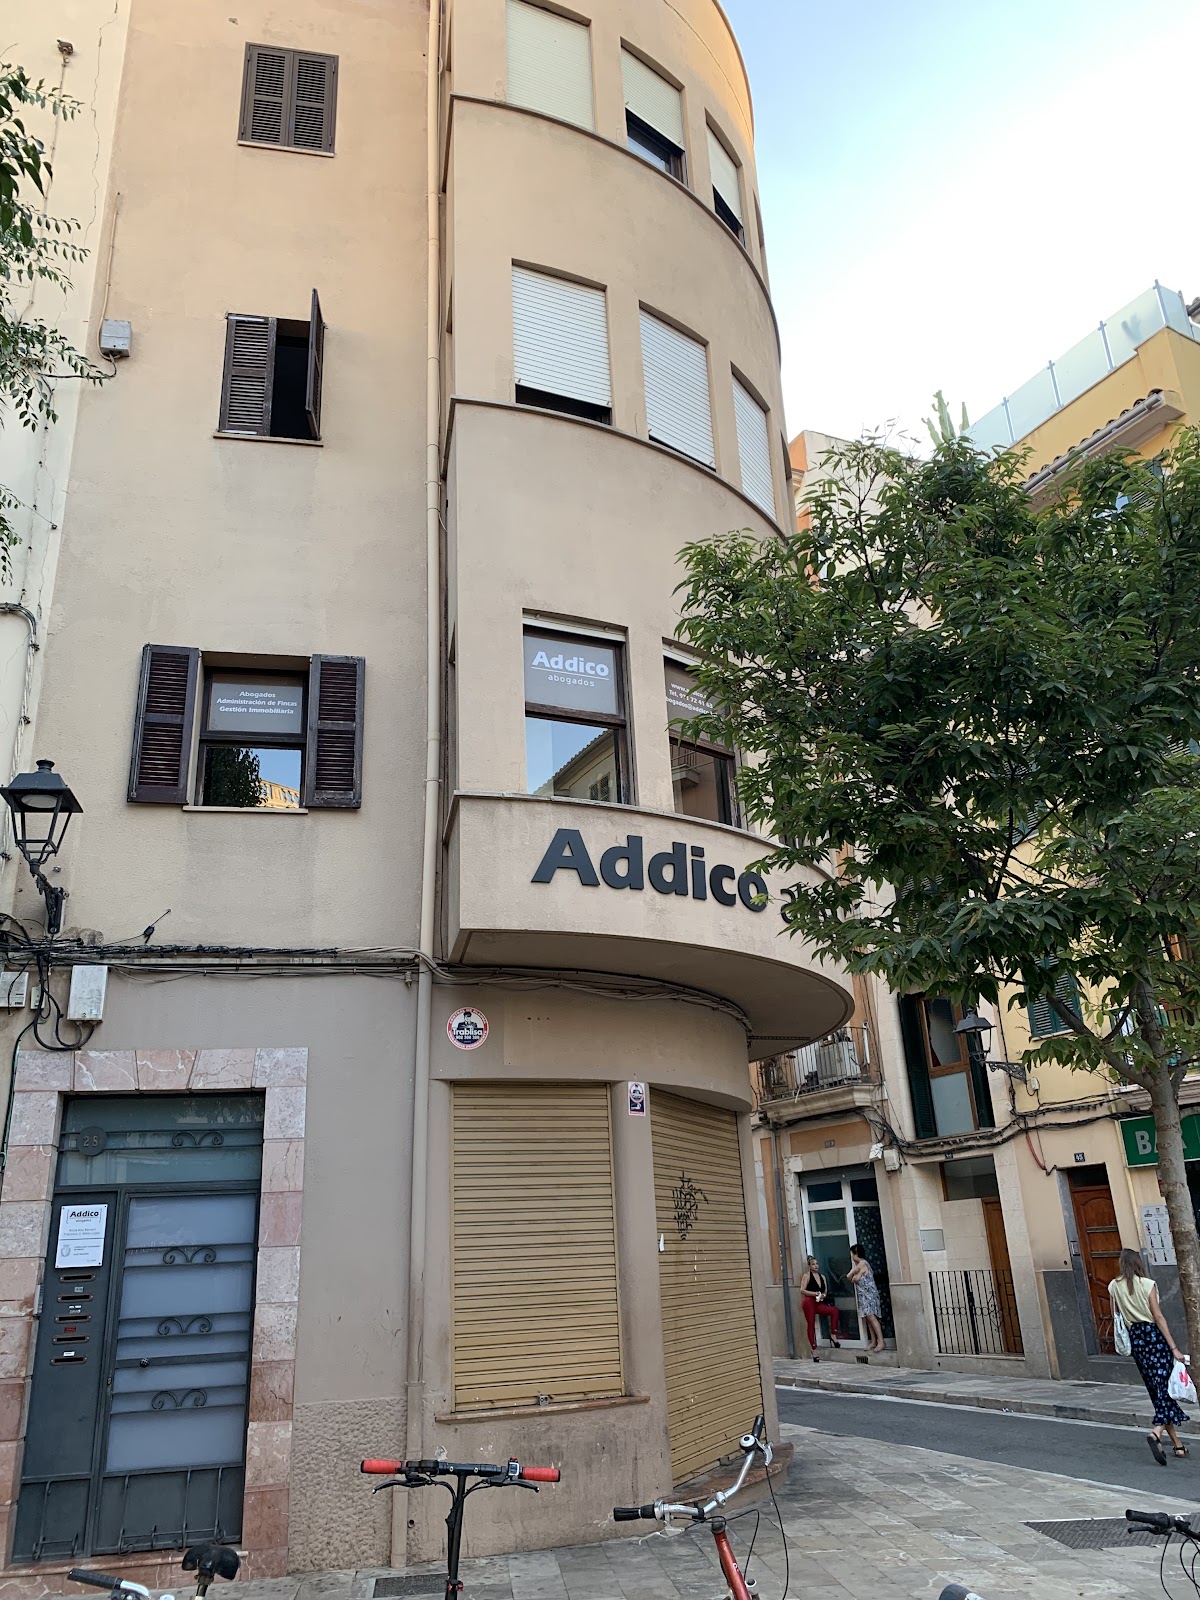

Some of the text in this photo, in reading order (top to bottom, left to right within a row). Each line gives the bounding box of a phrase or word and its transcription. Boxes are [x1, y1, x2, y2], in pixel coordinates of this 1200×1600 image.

[531, 650, 609, 676] Addico
[547, 674, 595, 687] abogados
[216, 698, 266, 706] Administración
[531, 828, 769, 913] Addico
[452, 1027, 483, 1036] Trablisa
[83, 1135, 98, 1147] 28
[69, 1210, 99, 1218] Addico
